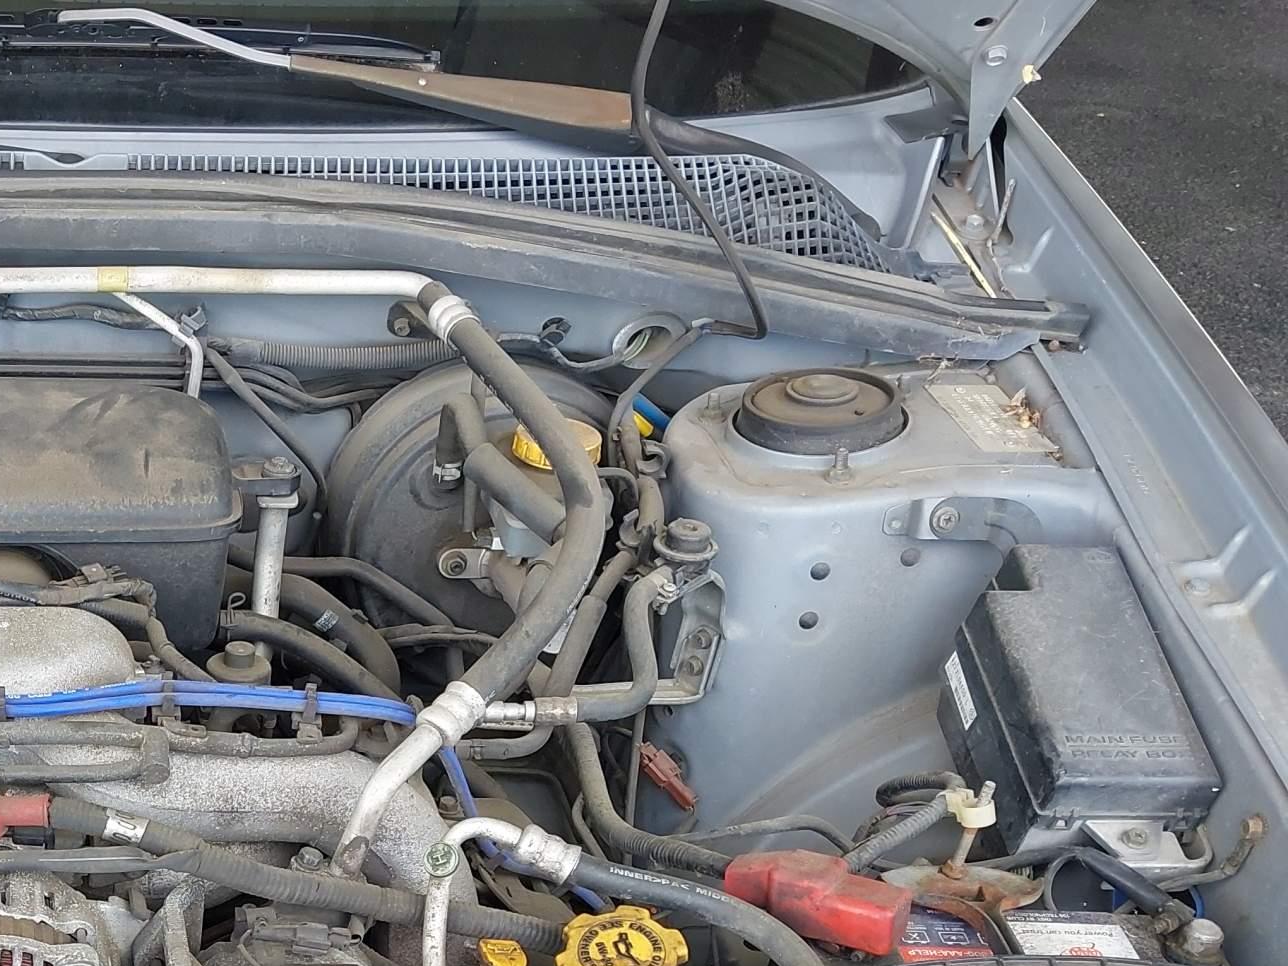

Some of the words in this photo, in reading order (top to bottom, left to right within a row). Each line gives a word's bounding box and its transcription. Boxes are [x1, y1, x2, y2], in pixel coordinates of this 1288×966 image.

[1064, 735, 1126, 744] MAIN
[1071, 750, 1139, 759] RELAY
[597, 920, 625, 932] SEE
[628, 922, 663, 953] ENGINE
